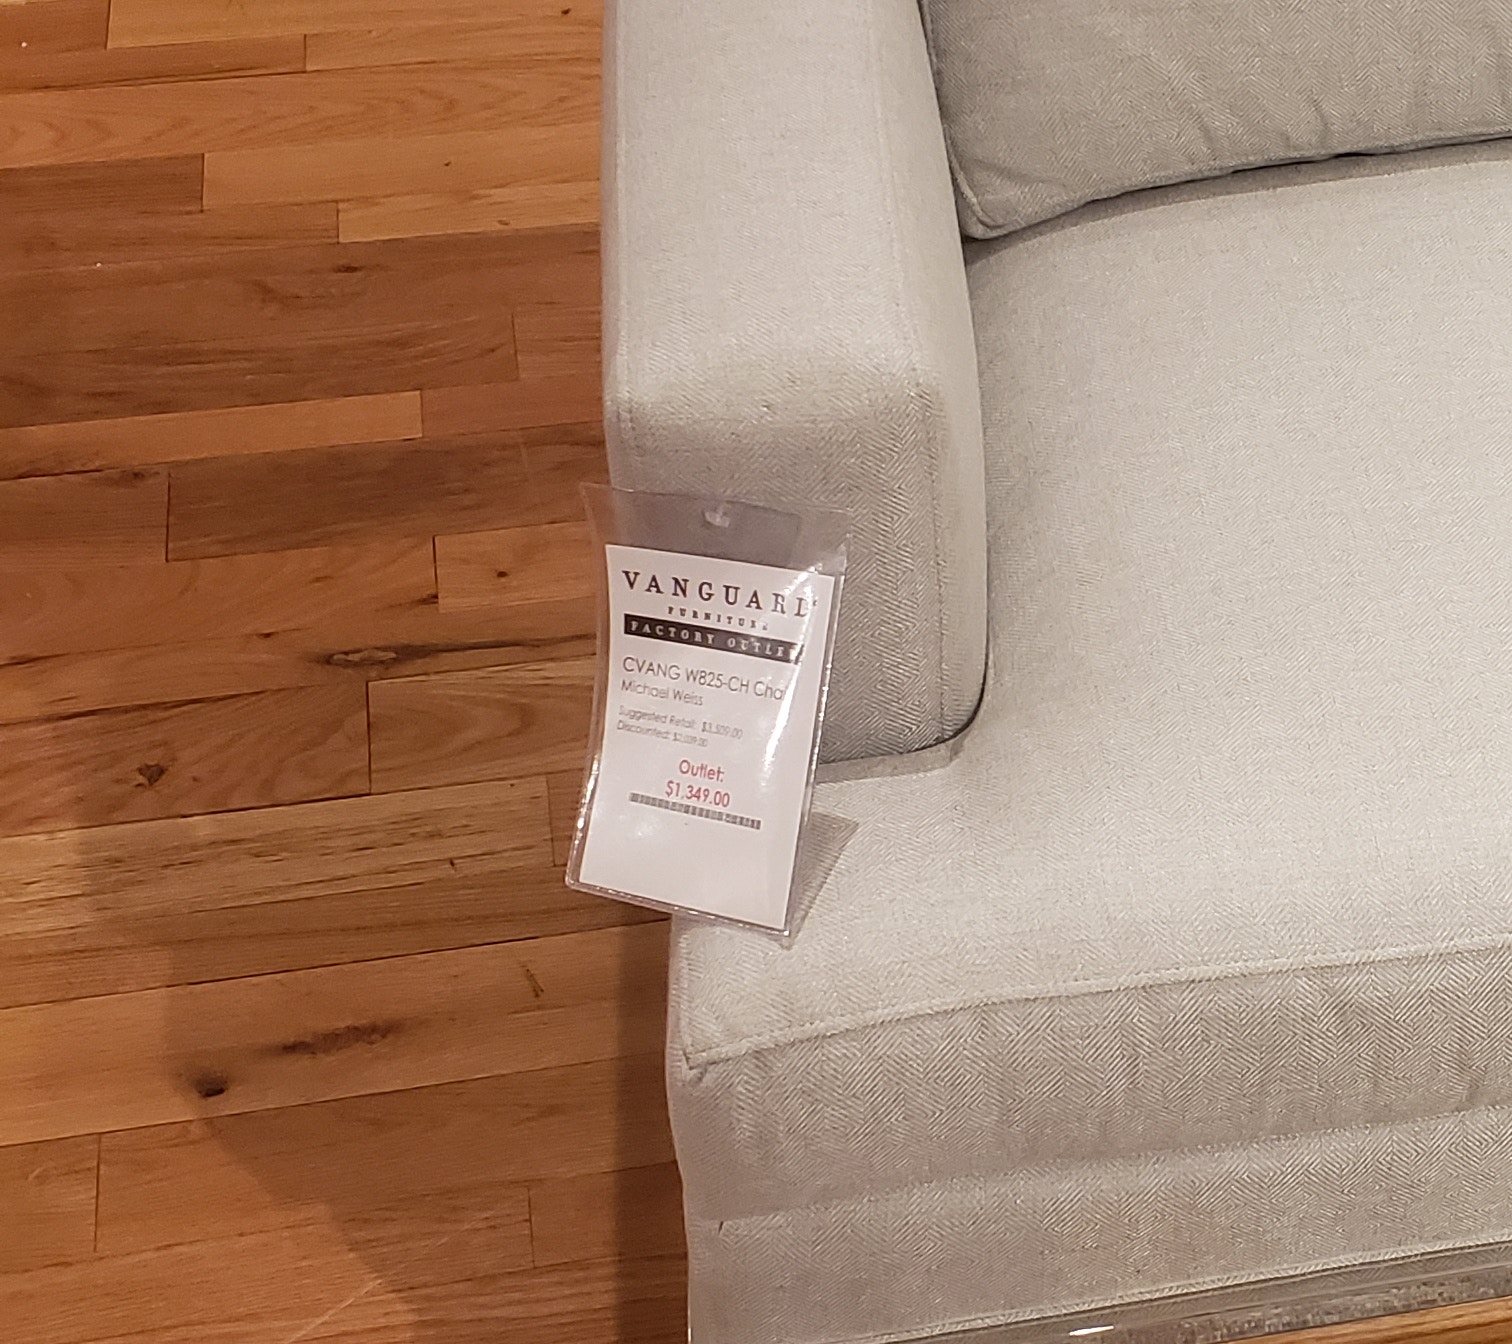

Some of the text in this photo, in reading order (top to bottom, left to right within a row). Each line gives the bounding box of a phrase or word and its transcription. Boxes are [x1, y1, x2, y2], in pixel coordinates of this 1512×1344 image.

[630, 620, 716, 645] FACTORY
[622, 656, 681, 681] CVANG
[686, 668, 750, 693] W825-CH
[621, 678, 704, 707] Michael Weiss
[678, 759, 725, 783] Outlet:
[665, 780, 731, 808] $1,349.00
